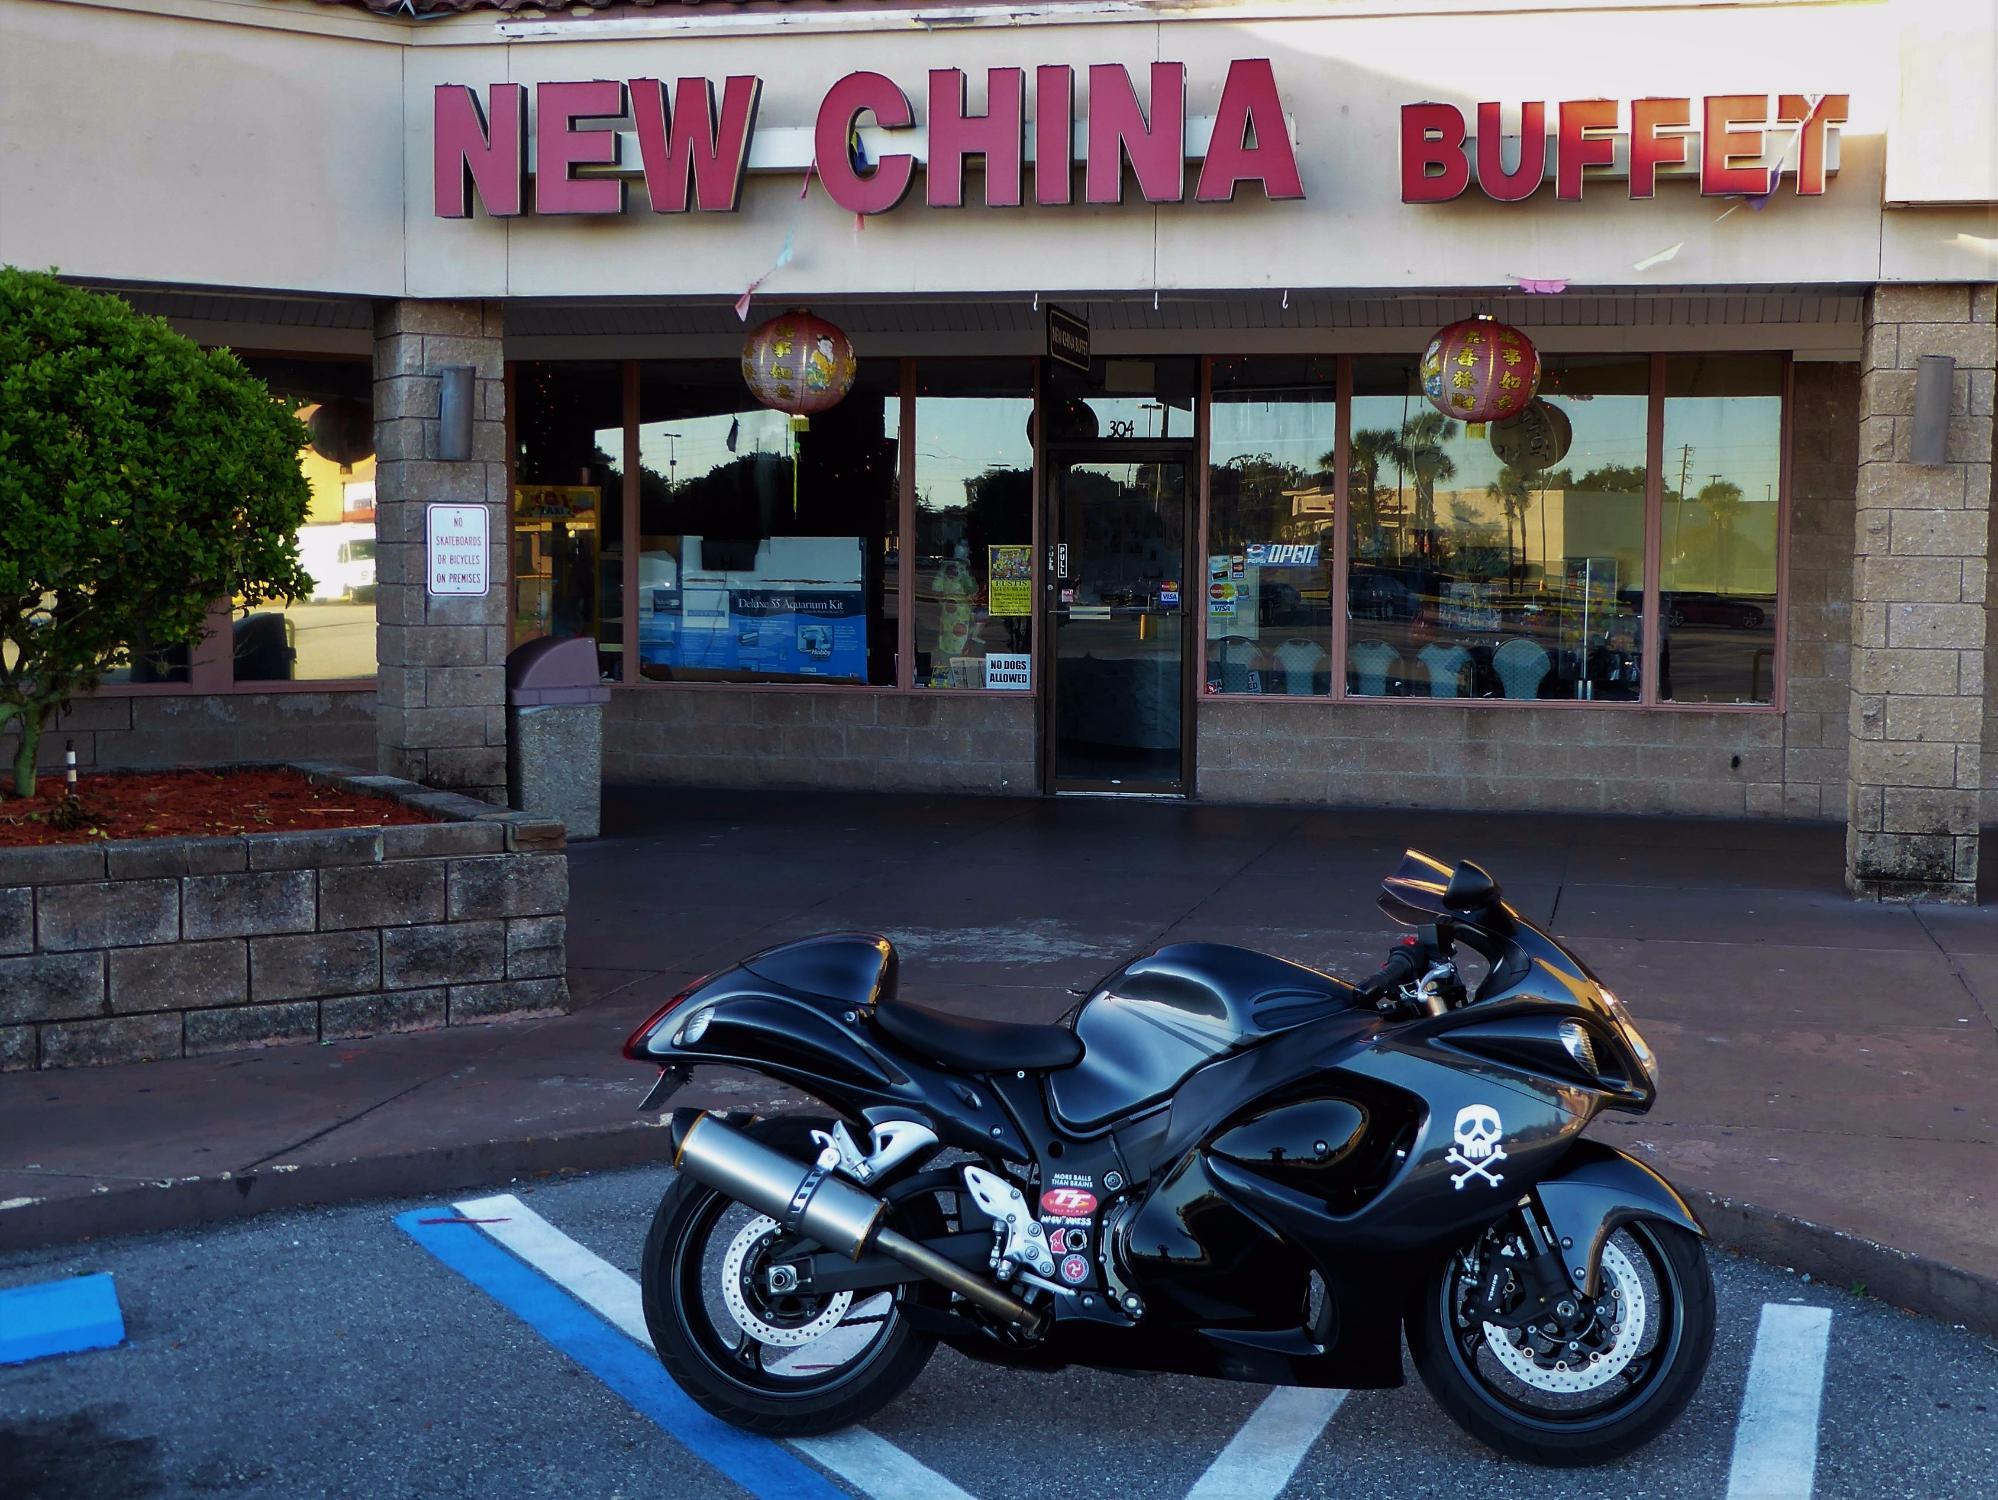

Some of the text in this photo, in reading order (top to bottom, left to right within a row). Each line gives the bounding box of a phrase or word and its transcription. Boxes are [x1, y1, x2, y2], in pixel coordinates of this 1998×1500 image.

[434, 58, 1849, 218] NEW CHINA BUFFET
[1109, 419, 1134, 438] 304
[453, 517, 463, 528] NO
[435, 535, 481, 546] SKATEBOARDS
[437, 554, 480, 565] OR BICYCLES
[1268, 544, 1315, 564] OPEN
[436, 573, 481, 584] ON PREMISES
[738, 598, 769, 608] Deluxe
[783, 599, 827, 611] Aquarium
[829, 599, 844, 610] Kit
[990, 660, 1027, 670] NO DOGS
[990, 673, 1027, 683] ALLOWED
[1051, 1178, 1093, 1188] THAN BRAINS
[1073, 1174, 1091, 1182] BALLS
[1053, 1189, 1091, 1208] TT
